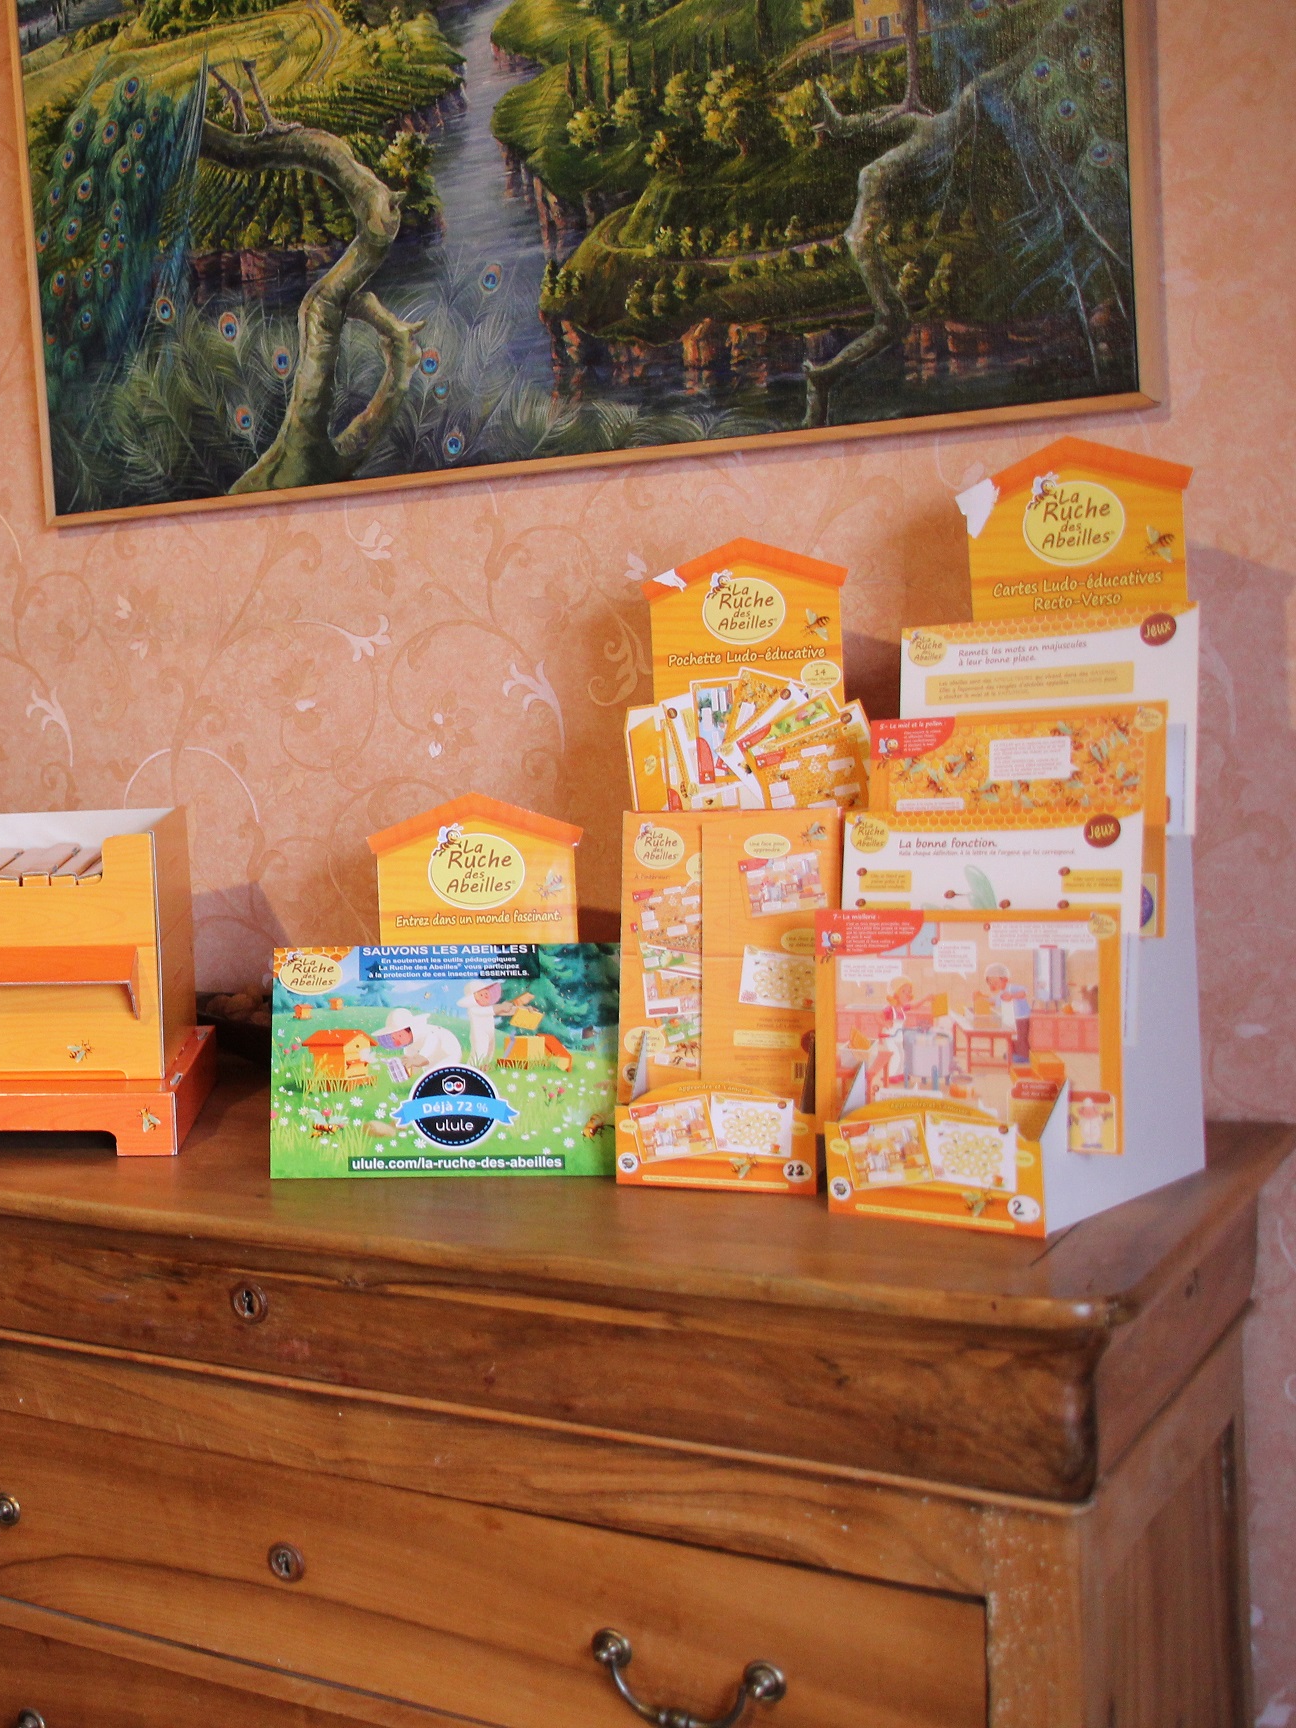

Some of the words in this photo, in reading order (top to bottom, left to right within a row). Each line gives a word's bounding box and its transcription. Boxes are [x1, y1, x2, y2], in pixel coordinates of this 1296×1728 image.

[1059, 489, 1079, 503] La
[1043, 498, 1110, 523] Ruche
[1061, 521, 1081, 532] des
[1042, 529, 1110, 549] Abeilles
[993, 582, 1037, 597] Cartes
[1043, 569, 1162, 593] Ludo-éducatives
[732, 584, 749, 596] La
[719, 591, 774, 610] Ruche
[1034, 593, 1121, 611] Recto-Verso
[734, 609, 750, 618] des
[718, 617, 774, 630] Abeilles
[1144, 621, 1171, 638] Jeux
[916, 639, 942, 650] Ruche
[959, 648, 988, 657] Remets
[1005, 645, 1025, 654] mots
[1042, 640, 1087, 652] majuscules
[668, 652, 721, 666] Pochette
[727, 646, 825, 664] Ludo-éducative
[914, 652, 942, 660] Abeilles
[959, 658, 963, 666] à
[966, 658, 982, 666] leur
[986, 656, 1010, 665] bonne
[1013, 654, 1036, 666] place.
[926, 721, 942, 730] pollen
[858, 826, 884, 836] Ruche
[1088, 823, 1115, 839] Jeux
[463, 840, 483, 854] La
[644, 837, 678, 847] Ruche
[899, 840, 911, 849] La
[916, 838, 947, 848] bonne
[951, 837, 997, 848] fonction.
[448, 850, 512, 869] Ruche
[643, 852, 677, 860] Abeilles
[465, 869, 484, 879] des
[396, 915, 430, 928] Entrez
[433, 913, 456, 926] dans
[459, 915, 473, 924] un
[476, 911, 510, 924] monde
[513, 909, 562, 923] fascinant.
[363, 947, 429, 956] SAUVONS
[432, 946, 458, 955] LES
[461, 945, 528, 954] ABEILLES
[292, 963, 334, 973] Ruche
[290, 977, 334, 986] Abeilles
[678, 1084, 712, 1092] Apprendre
[423, 1102, 453, 1115] Déjà
[457, 1101, 472, 1112] 72
[477, 1103, 488, 1113] %
[436, 1119, 474, 1132] ulule
[352, 1156, 562, 1170] ulule.com/la-ruche-des-abeilles
[787, 1164, 805, 1176] 22
[1013, 1200, 1024, 1215] 2
